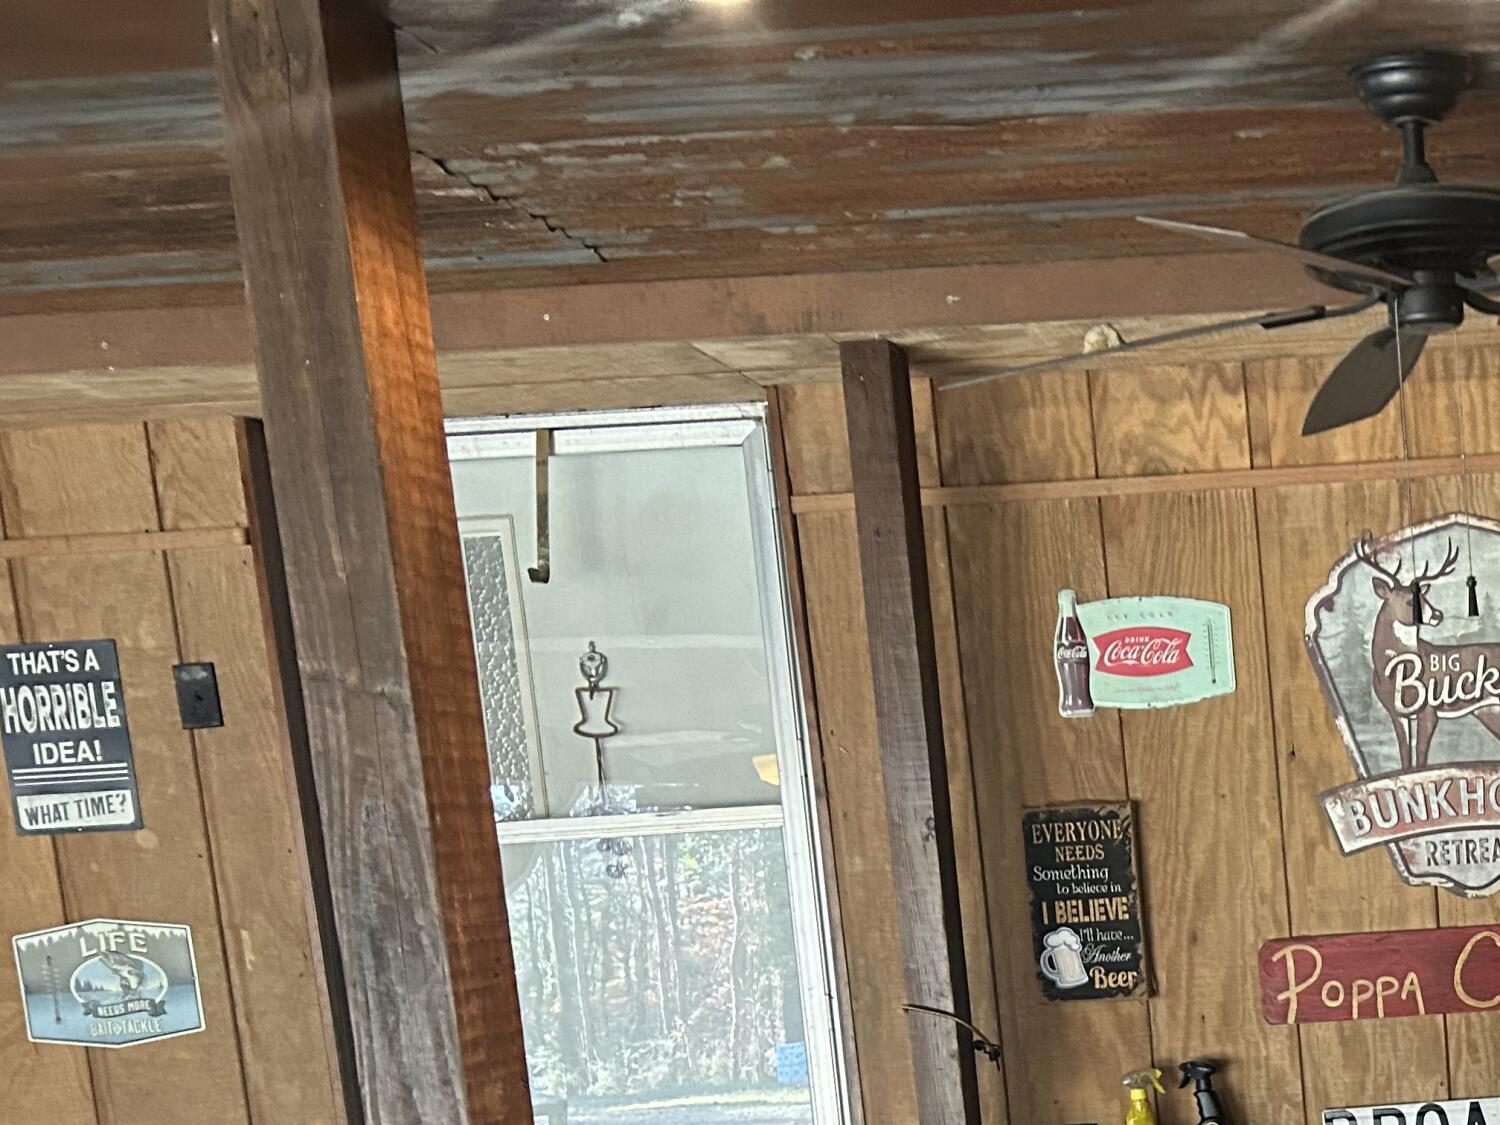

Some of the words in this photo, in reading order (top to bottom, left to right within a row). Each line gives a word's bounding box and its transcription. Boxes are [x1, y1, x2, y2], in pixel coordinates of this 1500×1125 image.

[6, 649, 80, 675] THAT'S
[84, 648, 100, 671] A
[1103, 638, 1183, 667] Coca-Cola
[1430, 653, 1461, 673] BIG
[0, 681, 121, 734] HORRIBLE
[33, 740, 103, 765] IDEA!
[24, 802, 70, 826] WHAT
[73, 793, 127, 819] TIME?
[1032, 820, 1123, 844] EVERYONE
[1055, 844, 1105, 862] NEEDS
[1033, 865, 1109, 882] Something
[1056, 884, 1070, 894] to
[1072, 882, 1108, 894] believe
[1110, 882, 1122, 893] in
[1042, 901, 1049, 925] I
[1055, 896, 1129, 924] BELIEVE
[80, 931, 148, 957] LIFE
[1081, 944, 1132, 964] Another
[1090, 966, 1138, 989] Beer
[97, 1003, 125, 1017] NEEDS
[127, 999, 151, 1012] MORE
